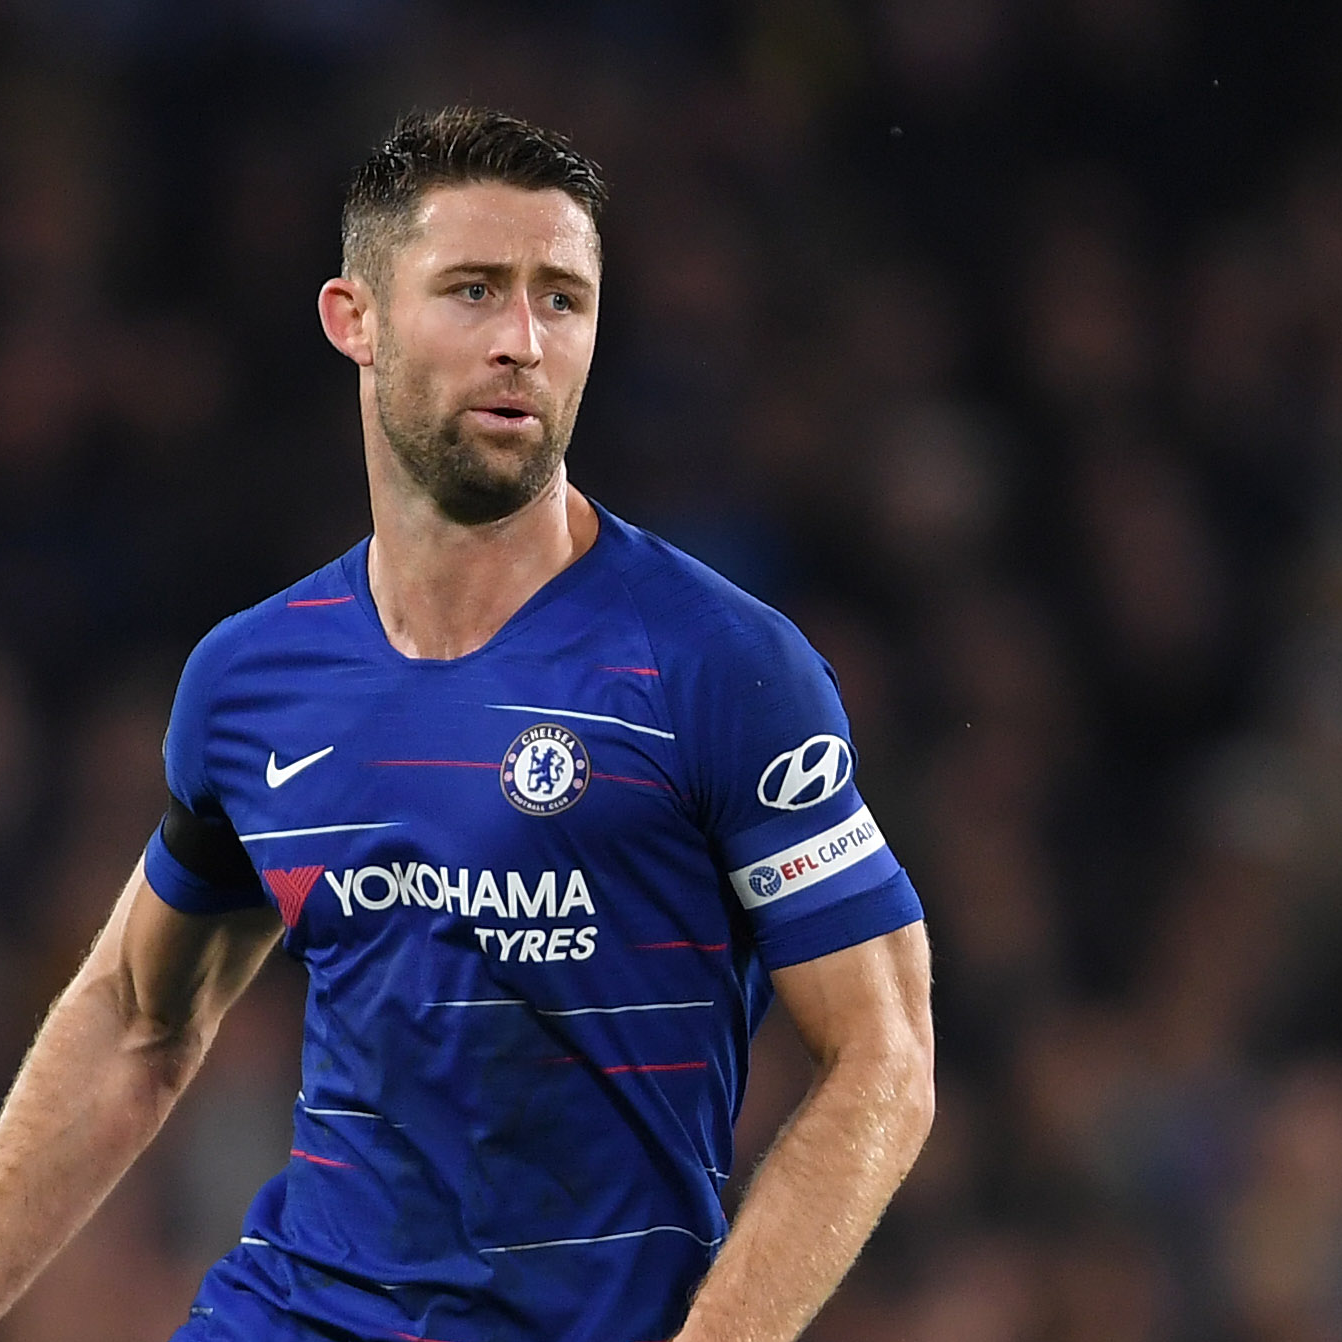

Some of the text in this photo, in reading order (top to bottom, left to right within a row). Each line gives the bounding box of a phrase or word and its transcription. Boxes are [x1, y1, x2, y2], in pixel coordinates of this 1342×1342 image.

[522, 728, 575, 750] CHELSEA
[780, 820, 877, 881] EFL CAPTAIN
[324, 861, 596, 919] YOKOHAMA
[474, 926, 598, 963] TYRES
